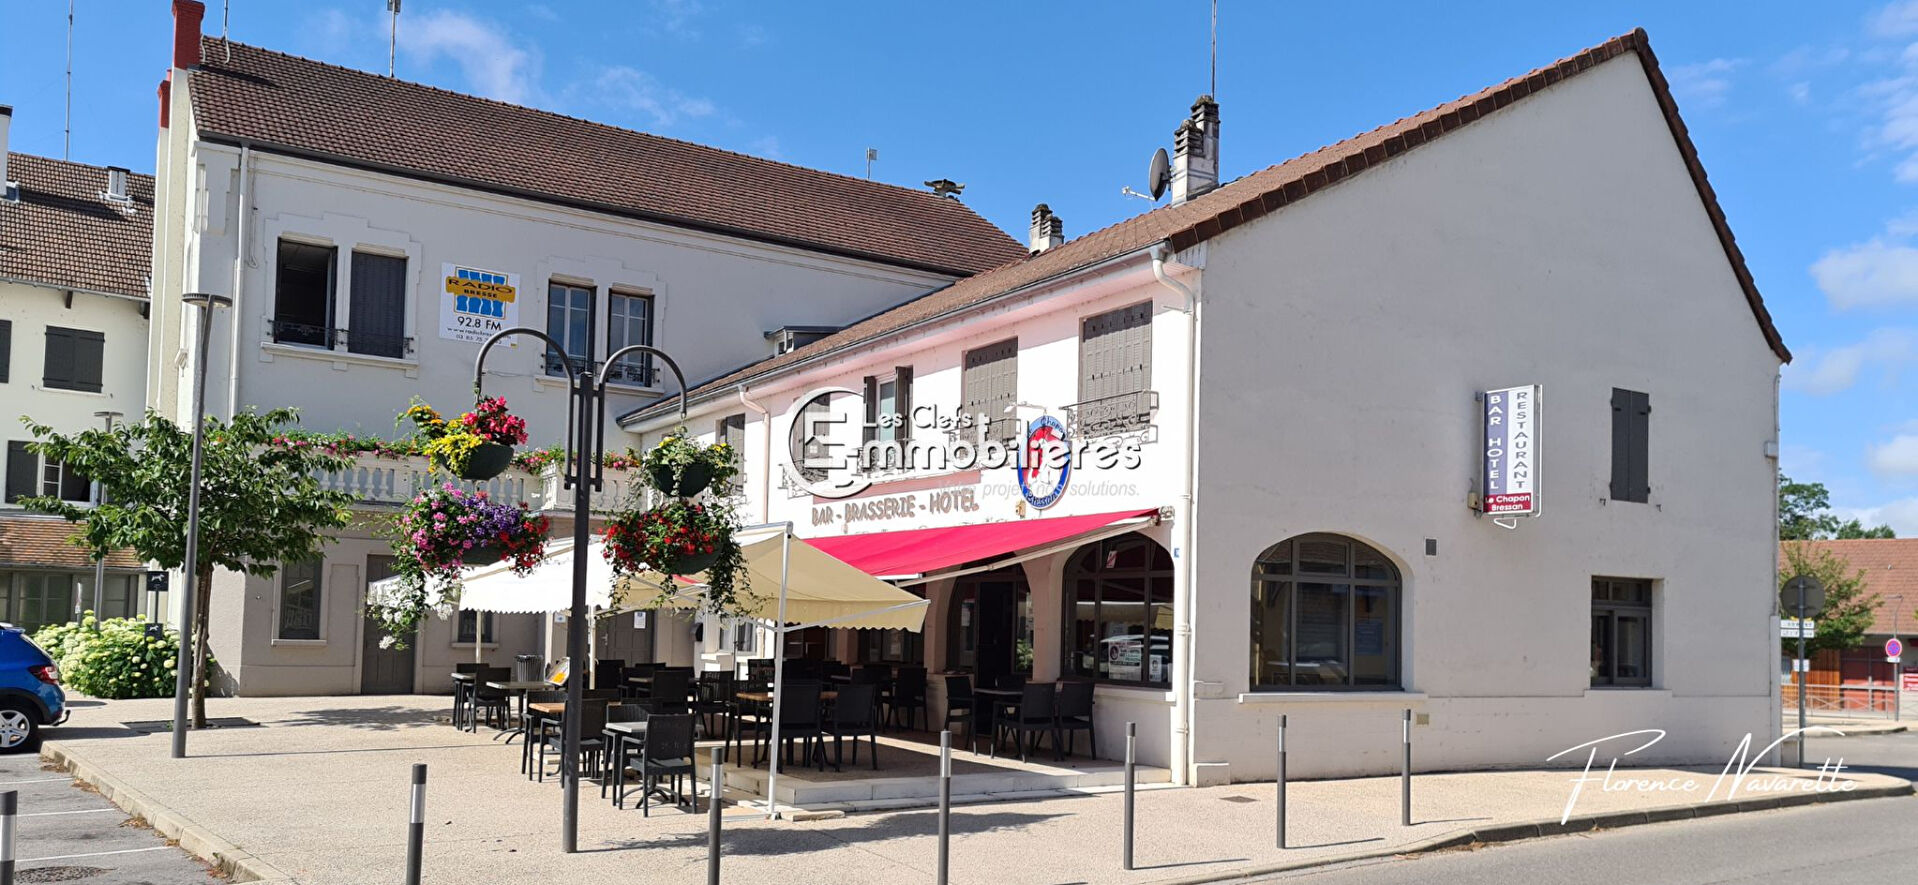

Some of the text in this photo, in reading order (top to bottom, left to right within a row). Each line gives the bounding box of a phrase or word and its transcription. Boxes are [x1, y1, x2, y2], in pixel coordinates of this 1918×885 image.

[448, 279, 513, 294] RADIO
[464, 289, 498, 298] BRESSE
[457, 316, 502, 331] 92.8 FM
[1487, 395, 1503, 489] BAR HOTEL
[1514, 392, 1529, 489] RESTAURANT
[1496, 494, 1530, 503] Chapon
[811, 505, 834, 527] BAR
[844, 494, 916, 524] BRASSERIE
[929, 487, 979, 515] HOTEL
[1491, 503, 1523, 511] Bressan
